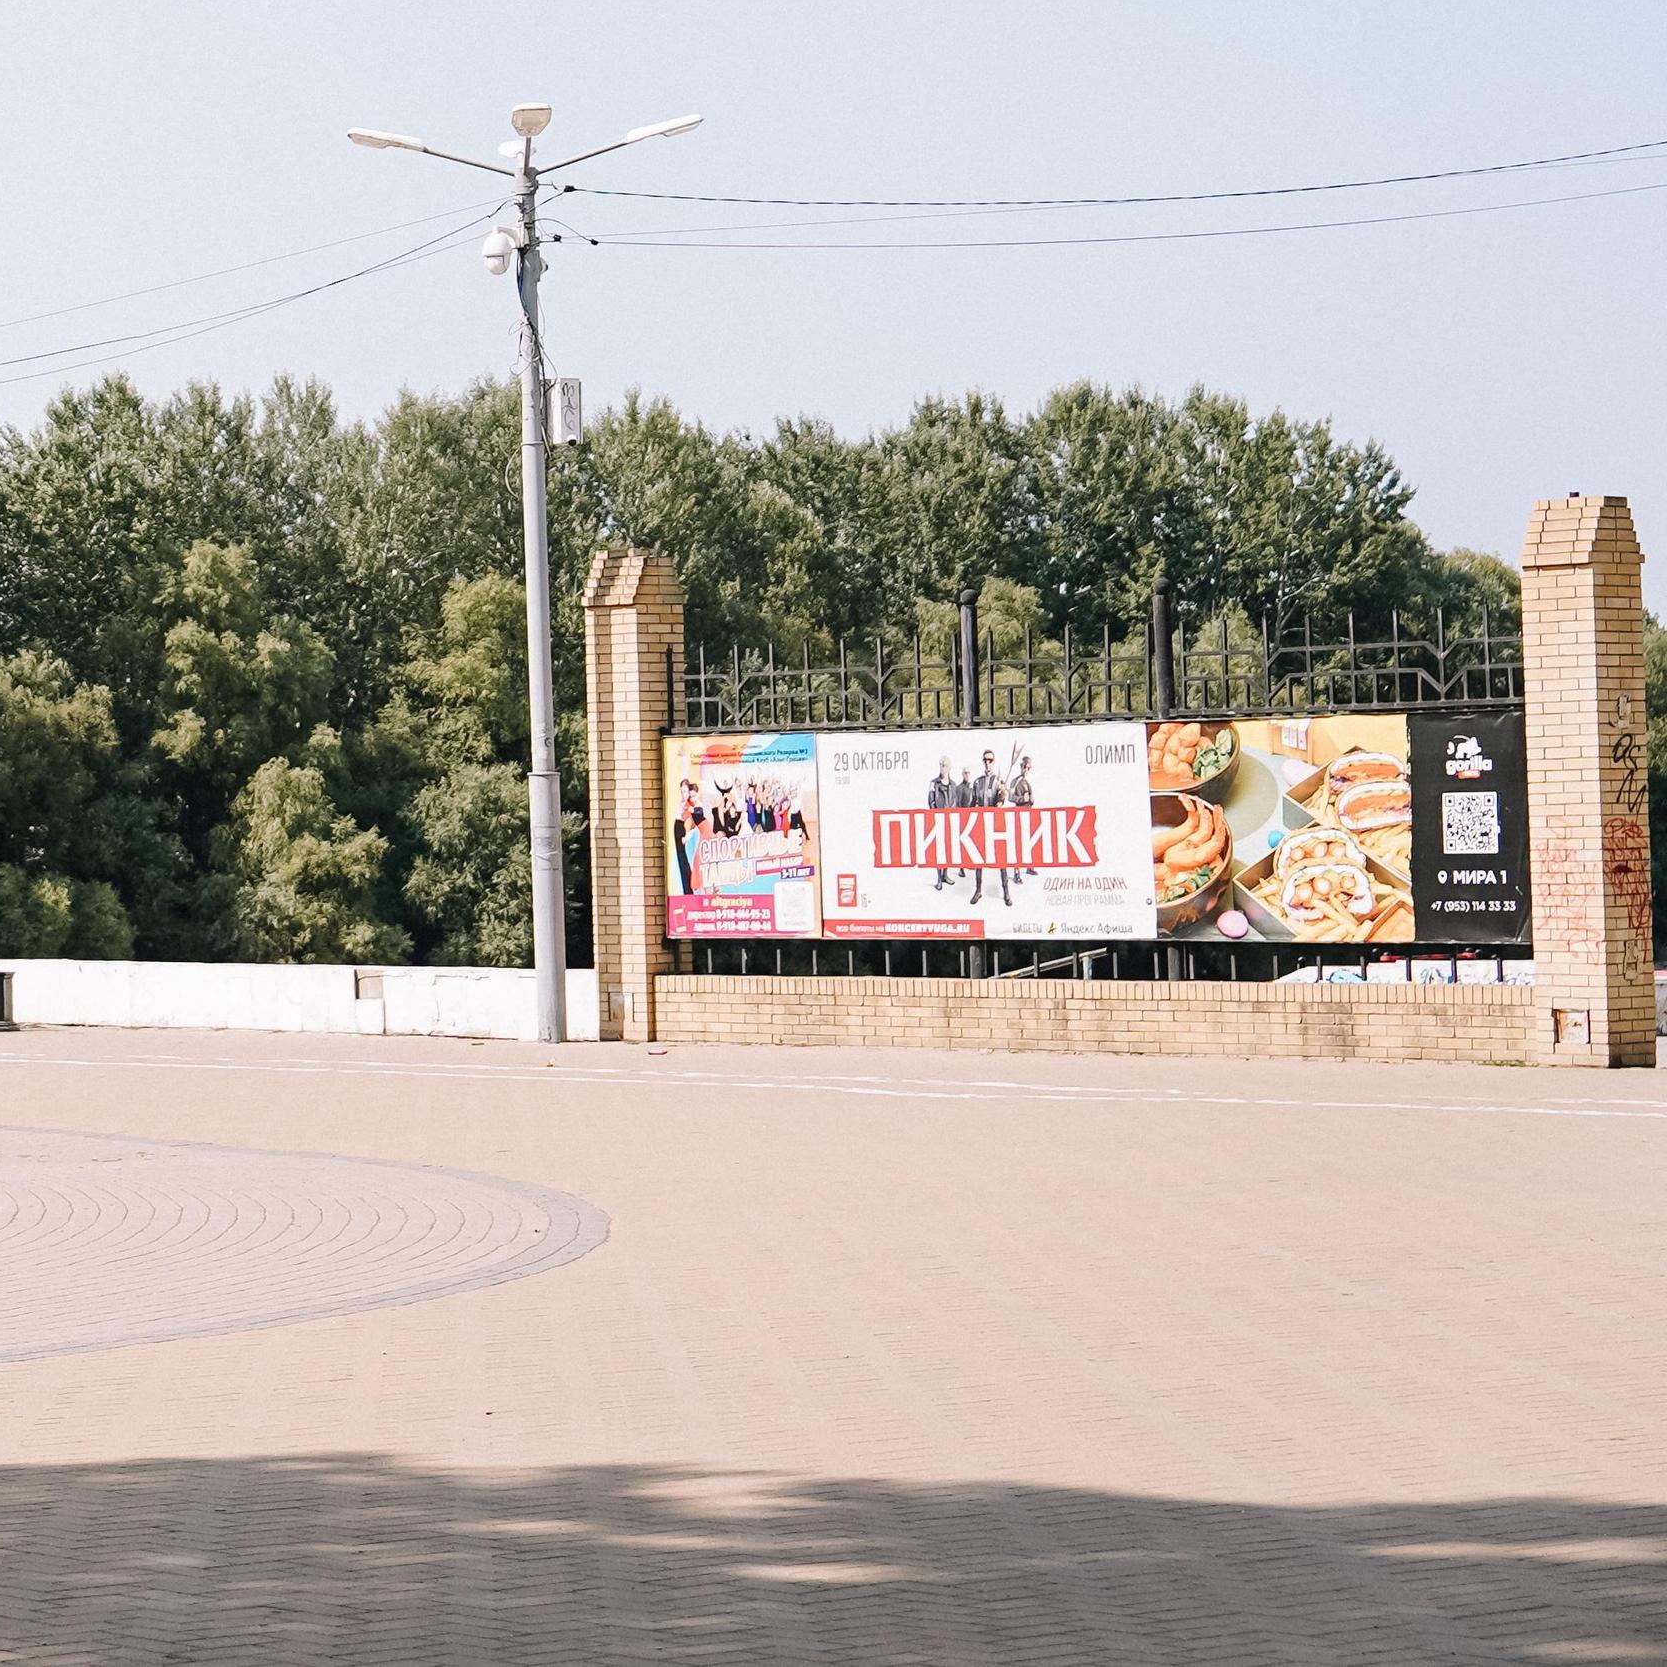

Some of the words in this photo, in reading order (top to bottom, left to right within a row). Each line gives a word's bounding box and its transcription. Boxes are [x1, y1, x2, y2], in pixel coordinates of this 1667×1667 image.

[834, 752, 849, 771] 29
[852, 751, 909, 770] ОКТЯБРЯ
[1085, 744, 1136, 765] ОЛИМП
[1446, 755, 1492, 775] gorilla
[880, 810, 1093, 865] ПИКНИК
[1043, 877, 1074, 891] ОДИН
[1078, 877, 1092, 890] НА
[1095, 877, 1127, 891] ОДИН
[1453, 870, 1497, 884] МИРА
[1500, 870, 1507, 884] 1
[1430, 901, 1442, 911] +7
[1444, 901, 1470, 912] (953)
[1472, 901, 1486, 911] 114
[1488, 901, 1501, 911] 33
[1503, 901, 1516, 911] 33
[1061, 922, 1094, 934] Яндекс
[1097, 922, 1133, 934] Афиша
